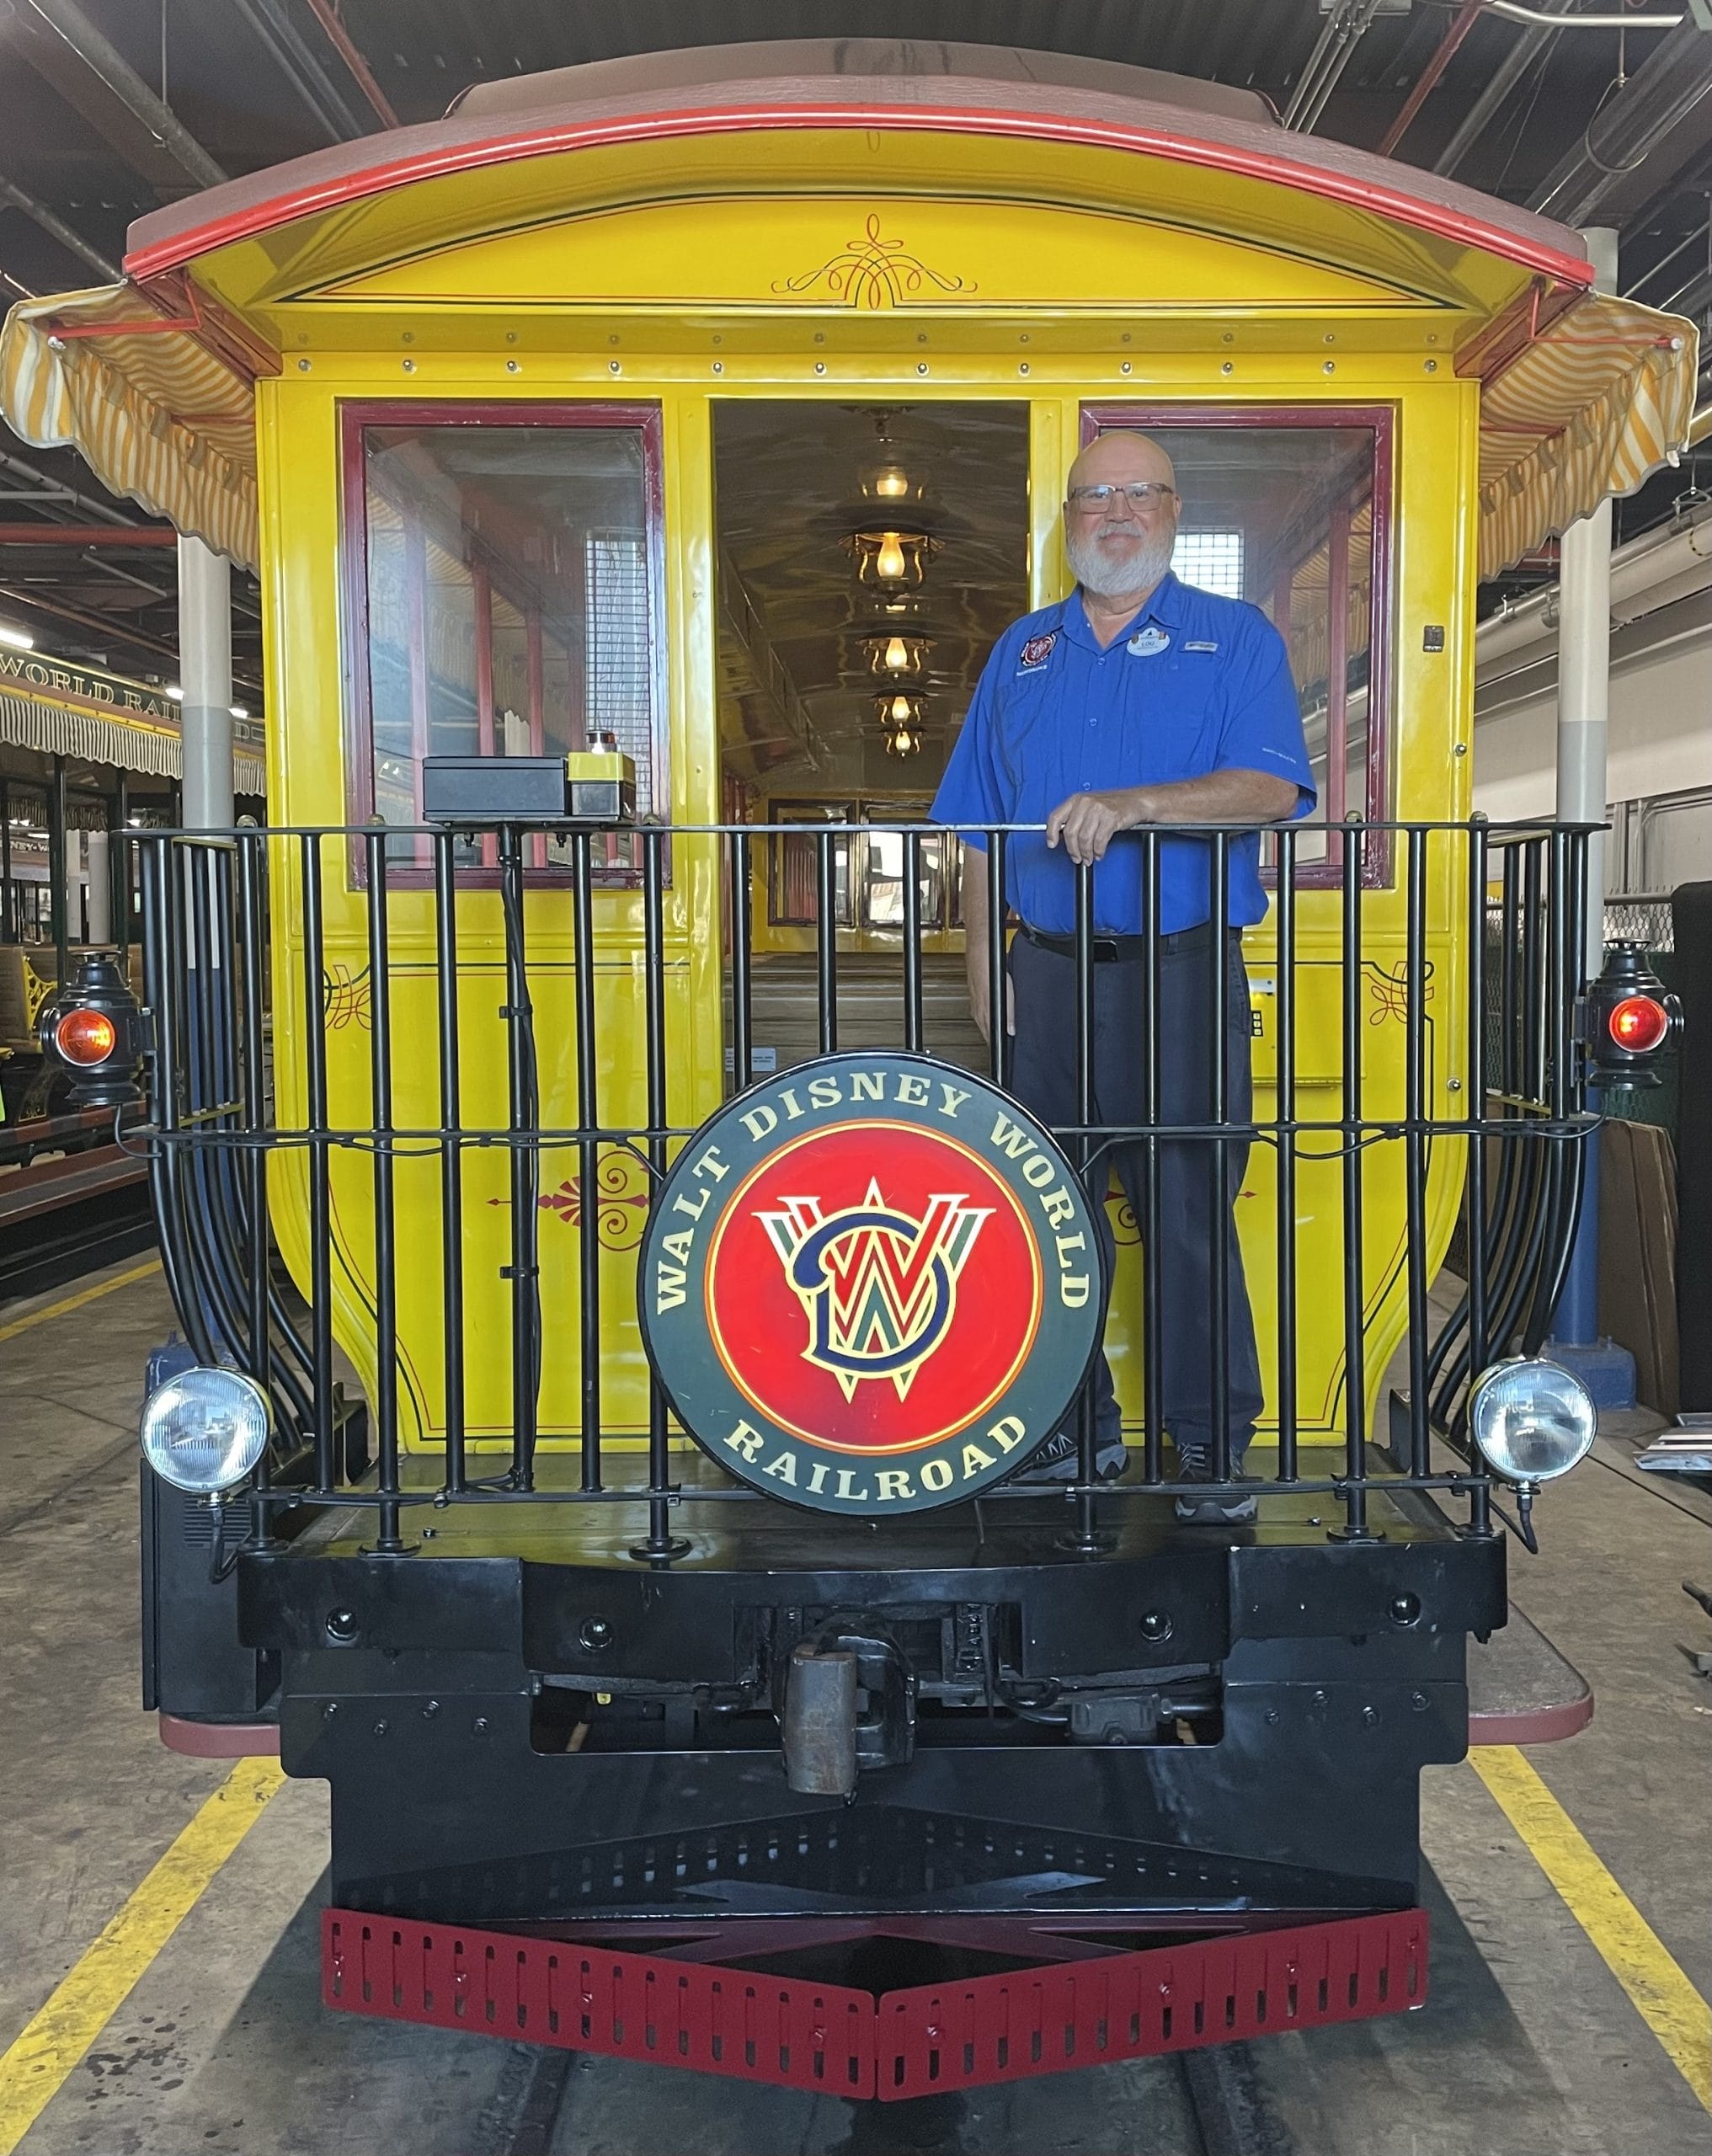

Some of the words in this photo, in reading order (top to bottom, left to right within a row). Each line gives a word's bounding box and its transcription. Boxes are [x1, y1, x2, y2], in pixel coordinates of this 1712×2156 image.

[0, 654, 115, 704] WORLD
[657, 1145, 731, 1315] WALT
[739, 1071, 973, 1143] DISNEY
[989, 1112, 1091, 1309] WORLD
[723, 1416, 1027, 1502] RAILROAD
